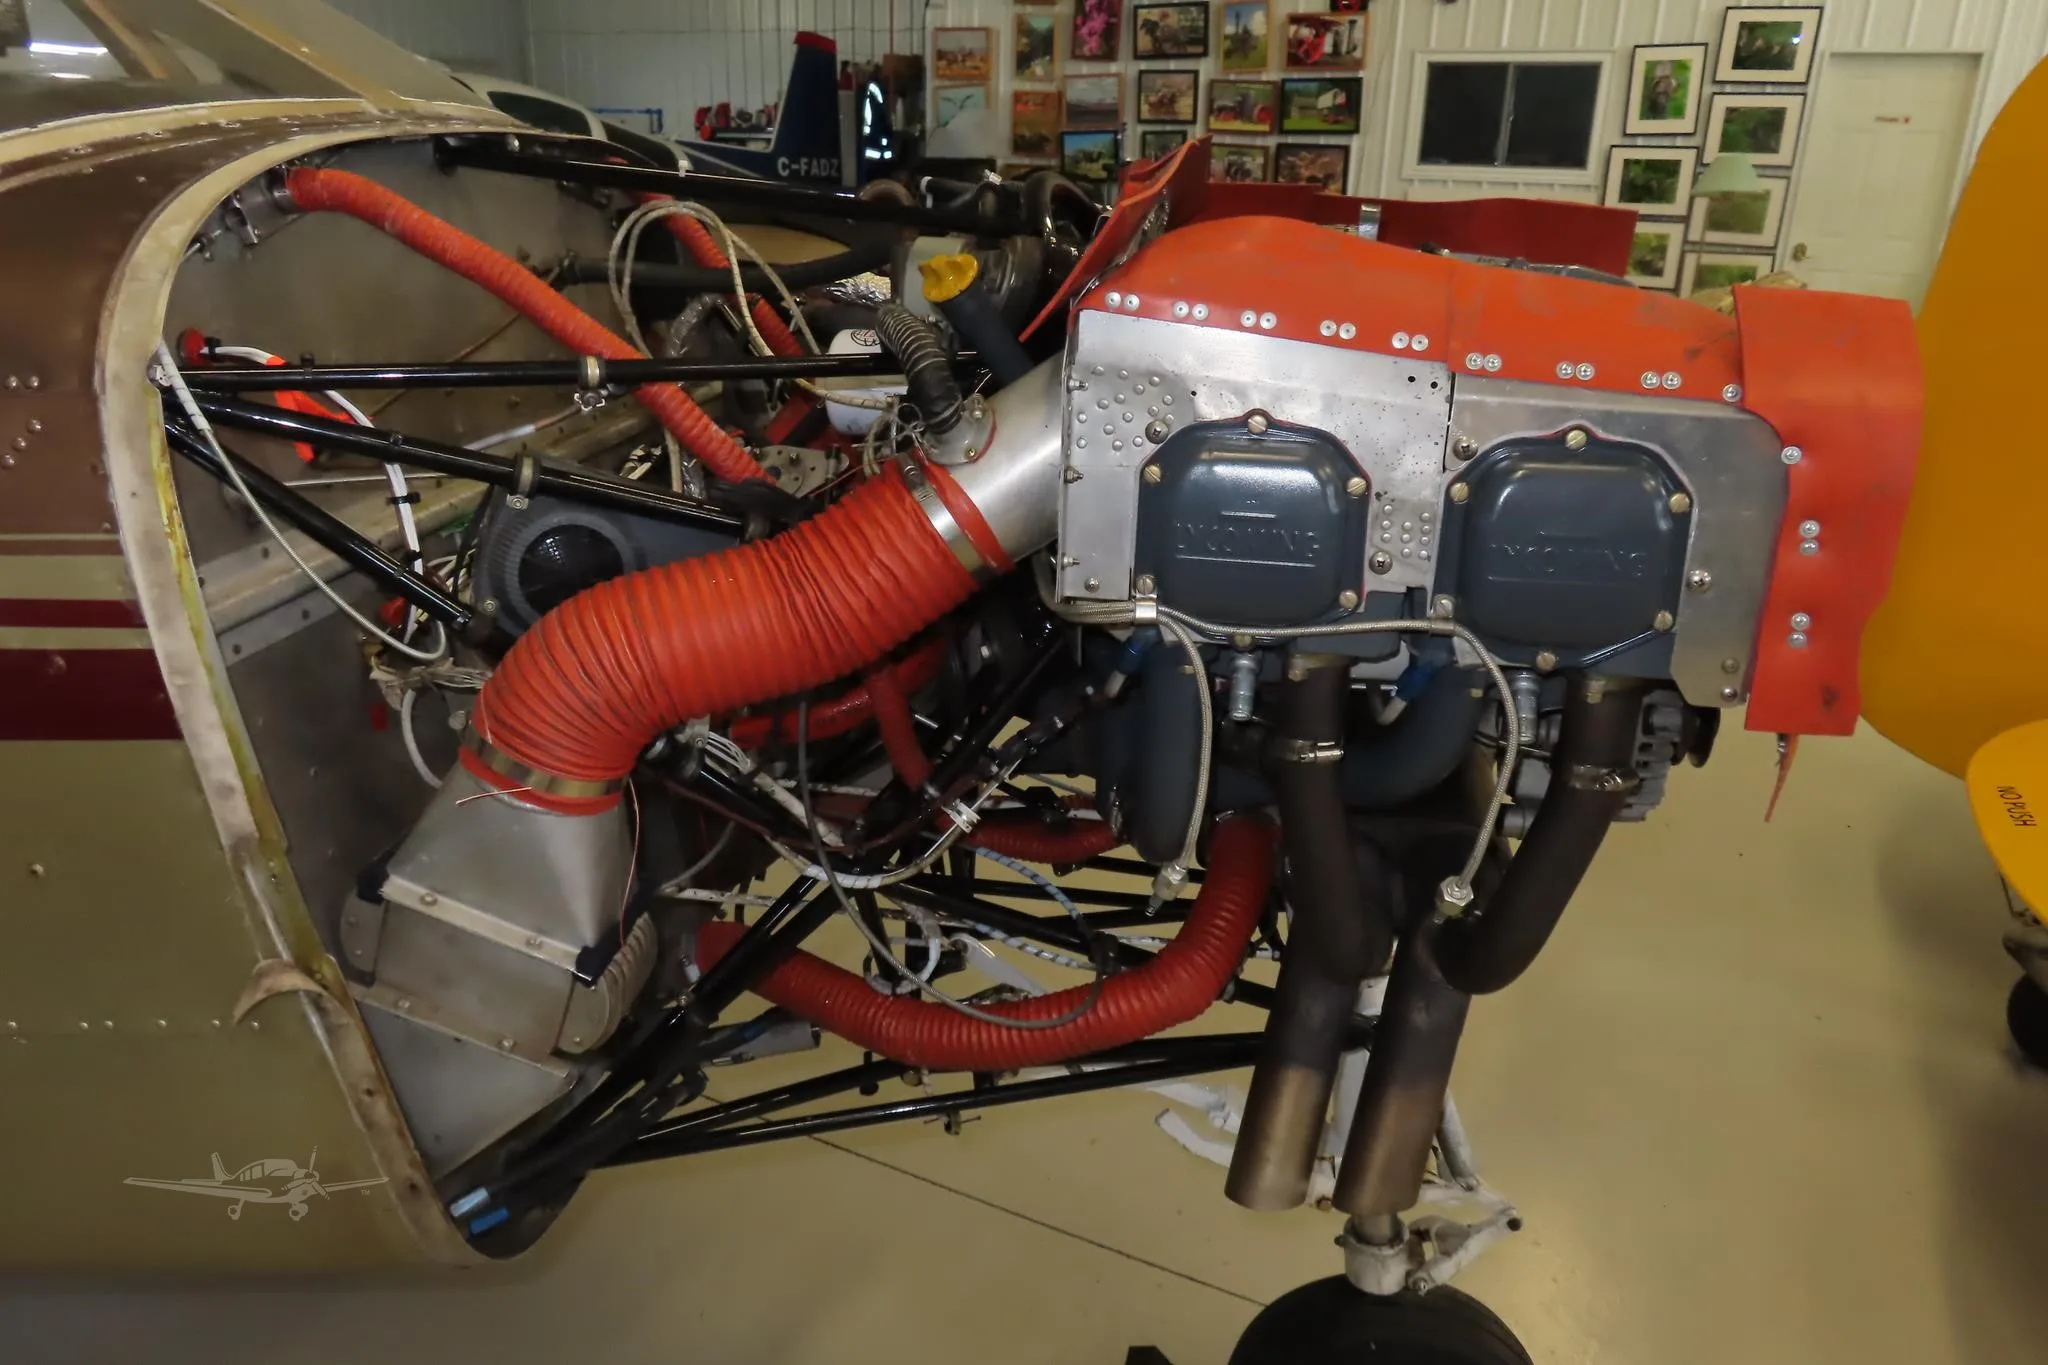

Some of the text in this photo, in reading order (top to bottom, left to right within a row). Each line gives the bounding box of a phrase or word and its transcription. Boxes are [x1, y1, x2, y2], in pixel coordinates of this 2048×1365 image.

[777, 156, 840, 177] C-FADZ
[1996, 785, 2038, 827] NO PUSH
